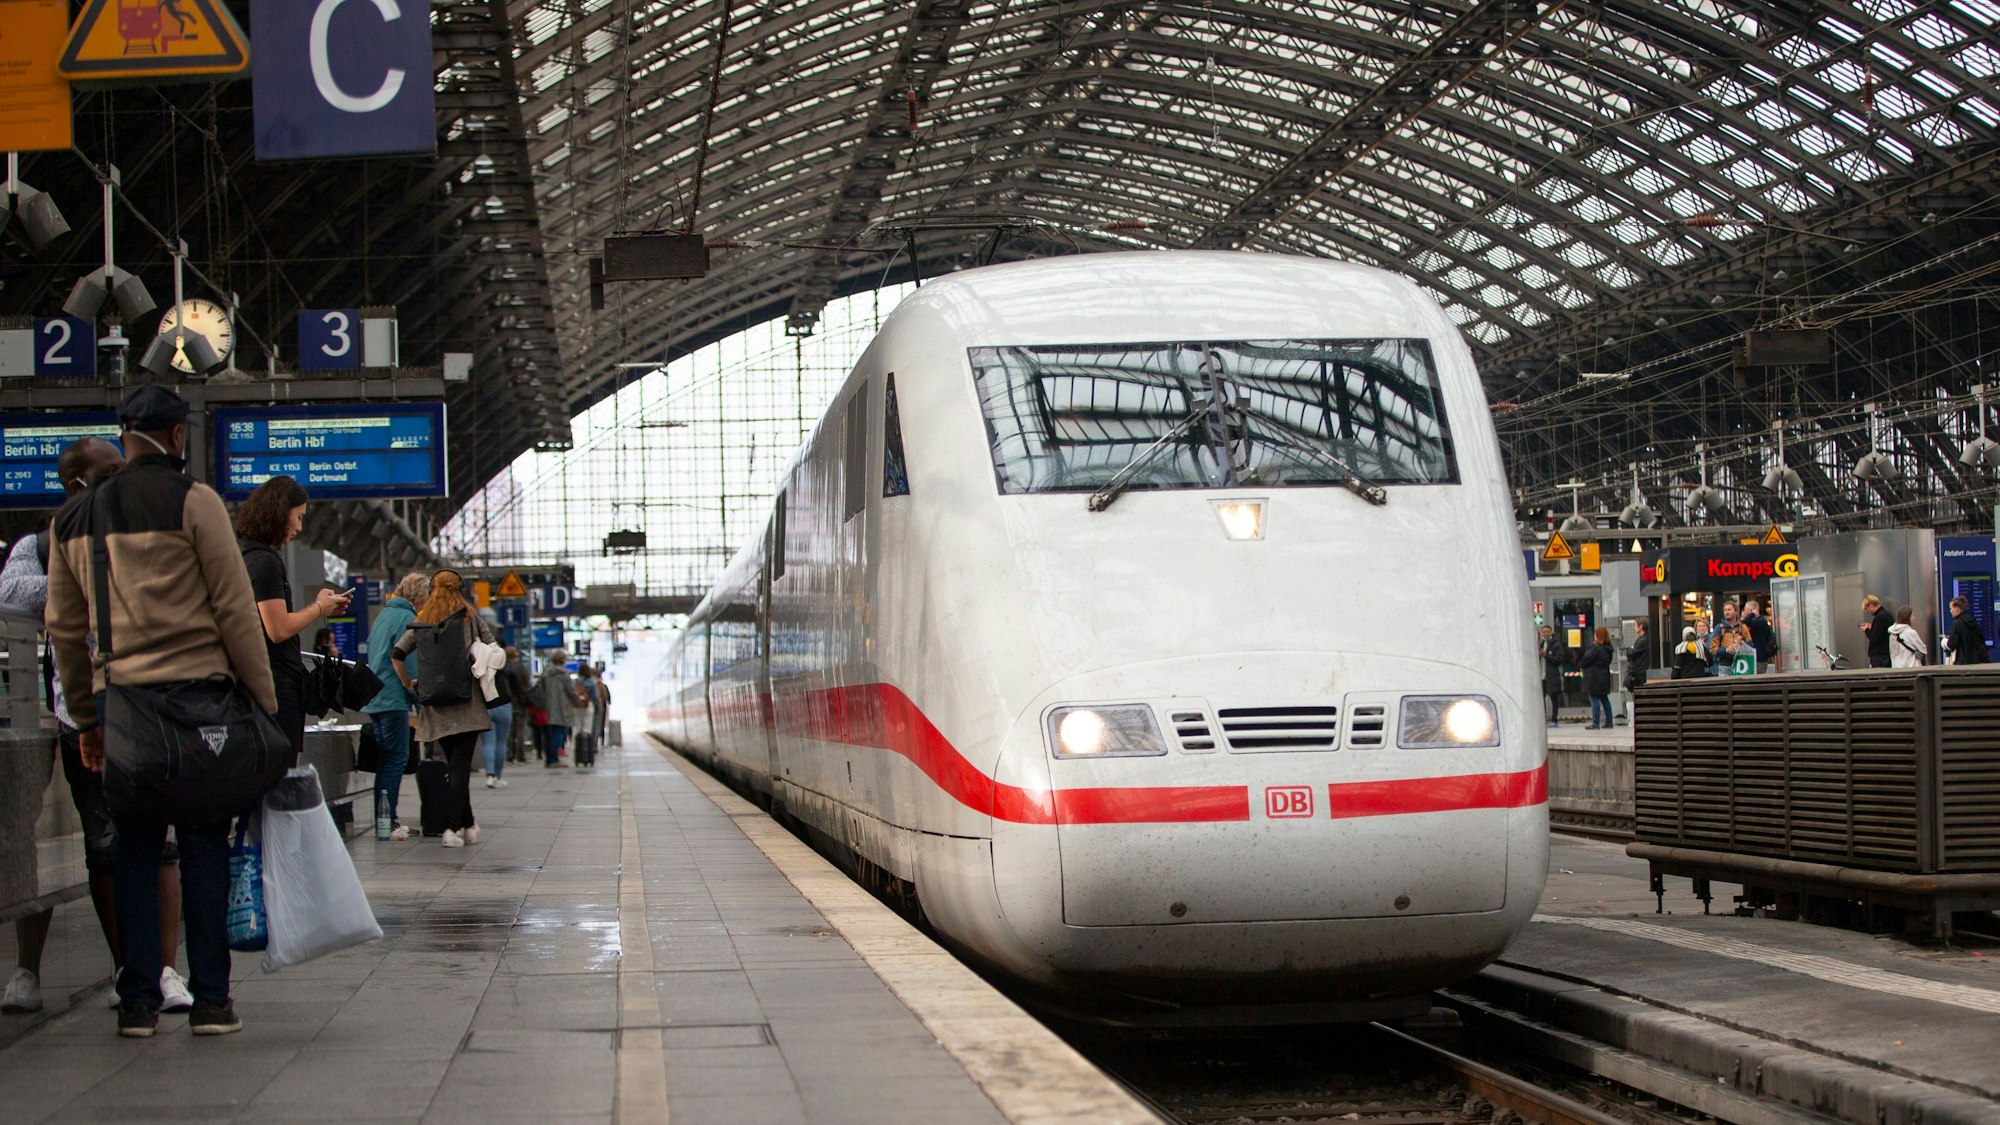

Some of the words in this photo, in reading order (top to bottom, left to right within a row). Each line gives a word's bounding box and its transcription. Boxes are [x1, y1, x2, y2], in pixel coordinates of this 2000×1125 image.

[309, 0, 405, 113] C
[43, 319, 73, 365] 2
[321, 311, 351, 357] 3
[5, 445, 37, 456] Berlin
[40, 444, 60, 455] Hbf
[268, 437, 302, 449] Berlin
[305, 436, 325, 448] Hbf
[14, 471, 32, 479] 2043
[45, 470, 59, 478] Han
[283, 463, 300, 471] 1153
[309, 462, 331, 471] Berlin
[309, 473, 347, 482] Dortmund
[1707, 559, 1774, 580] Kamps
[552, 586, 571, 609] D
[1271, 791, 1308, 813] DB
